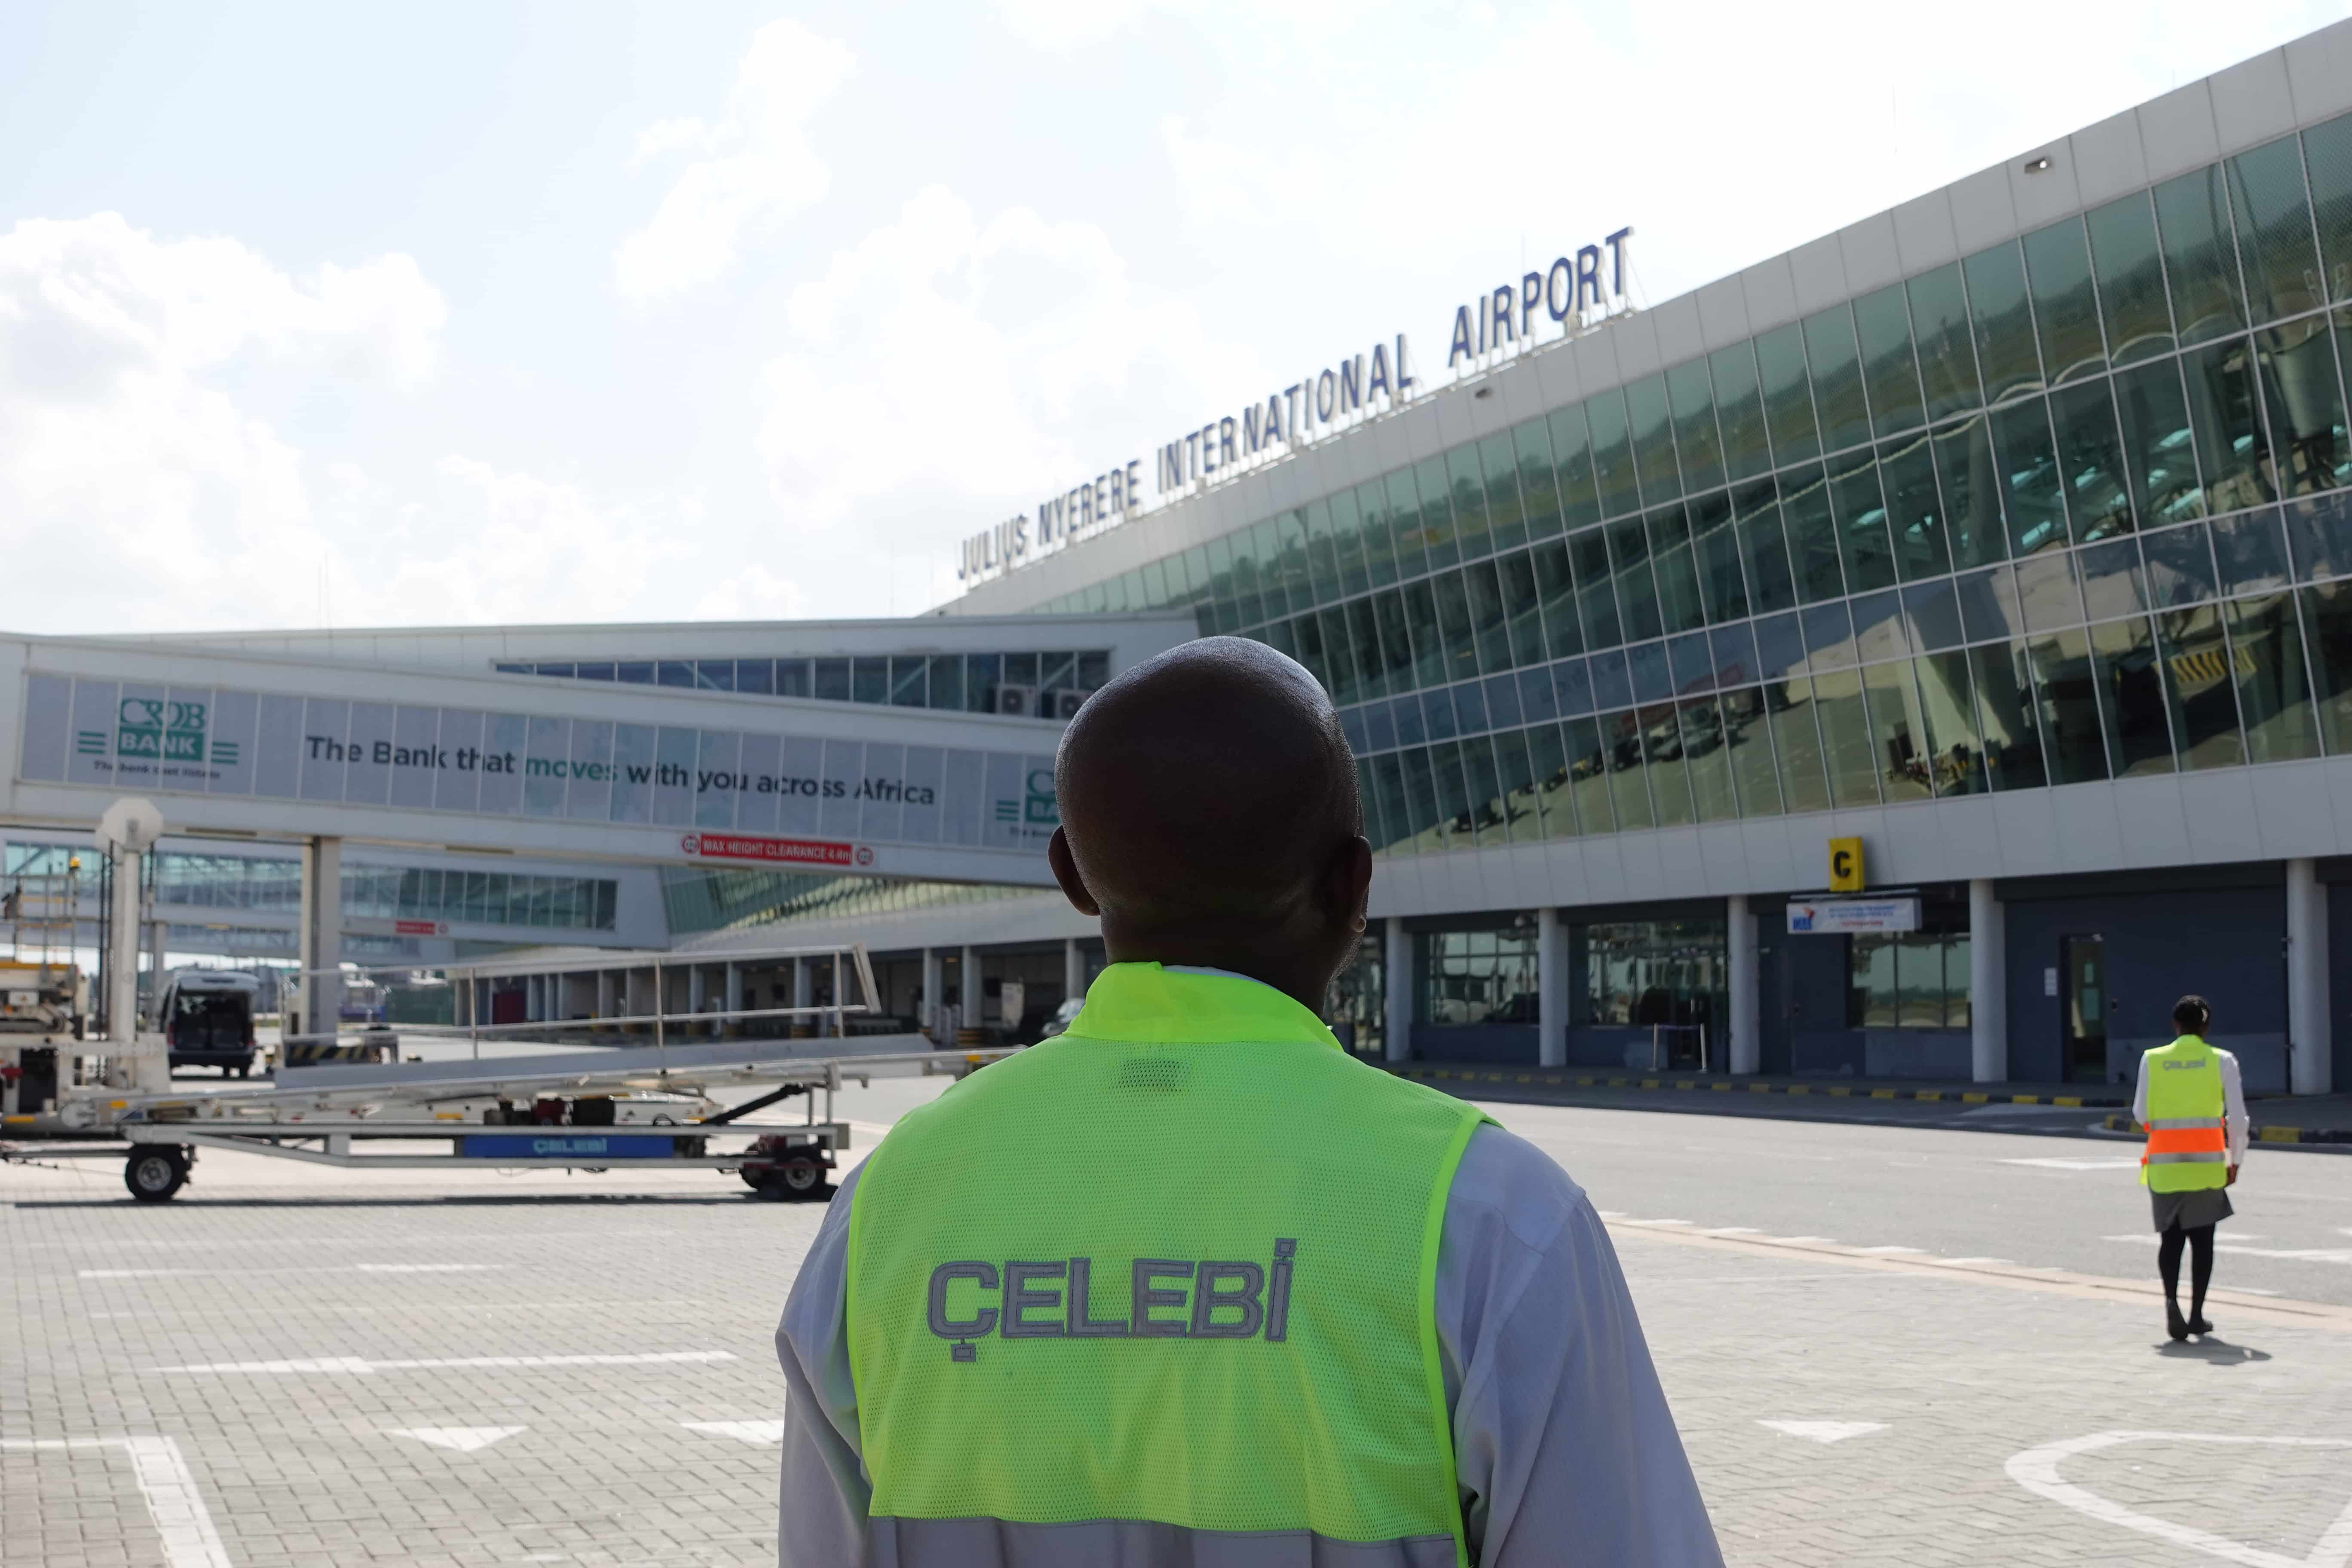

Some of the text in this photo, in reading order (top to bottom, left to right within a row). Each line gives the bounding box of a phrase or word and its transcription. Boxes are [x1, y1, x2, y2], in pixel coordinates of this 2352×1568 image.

[958, 226, 1635, 580] JULIUS NYERERE INTERNATIONAL AIRPORT
[120, 732, 196, 755] BANK
[306, 735, 936, 805] The Bank that moves with you across Africa
[703, 839, 725, 853] MAX
[727, 840, 764, 856] HEIGHT
[766, 843, 826, 860] CLEARANCE
[1833, 850, 1851, 879] C
[926, 1237, 1297, 1363] ÇELEBİ
